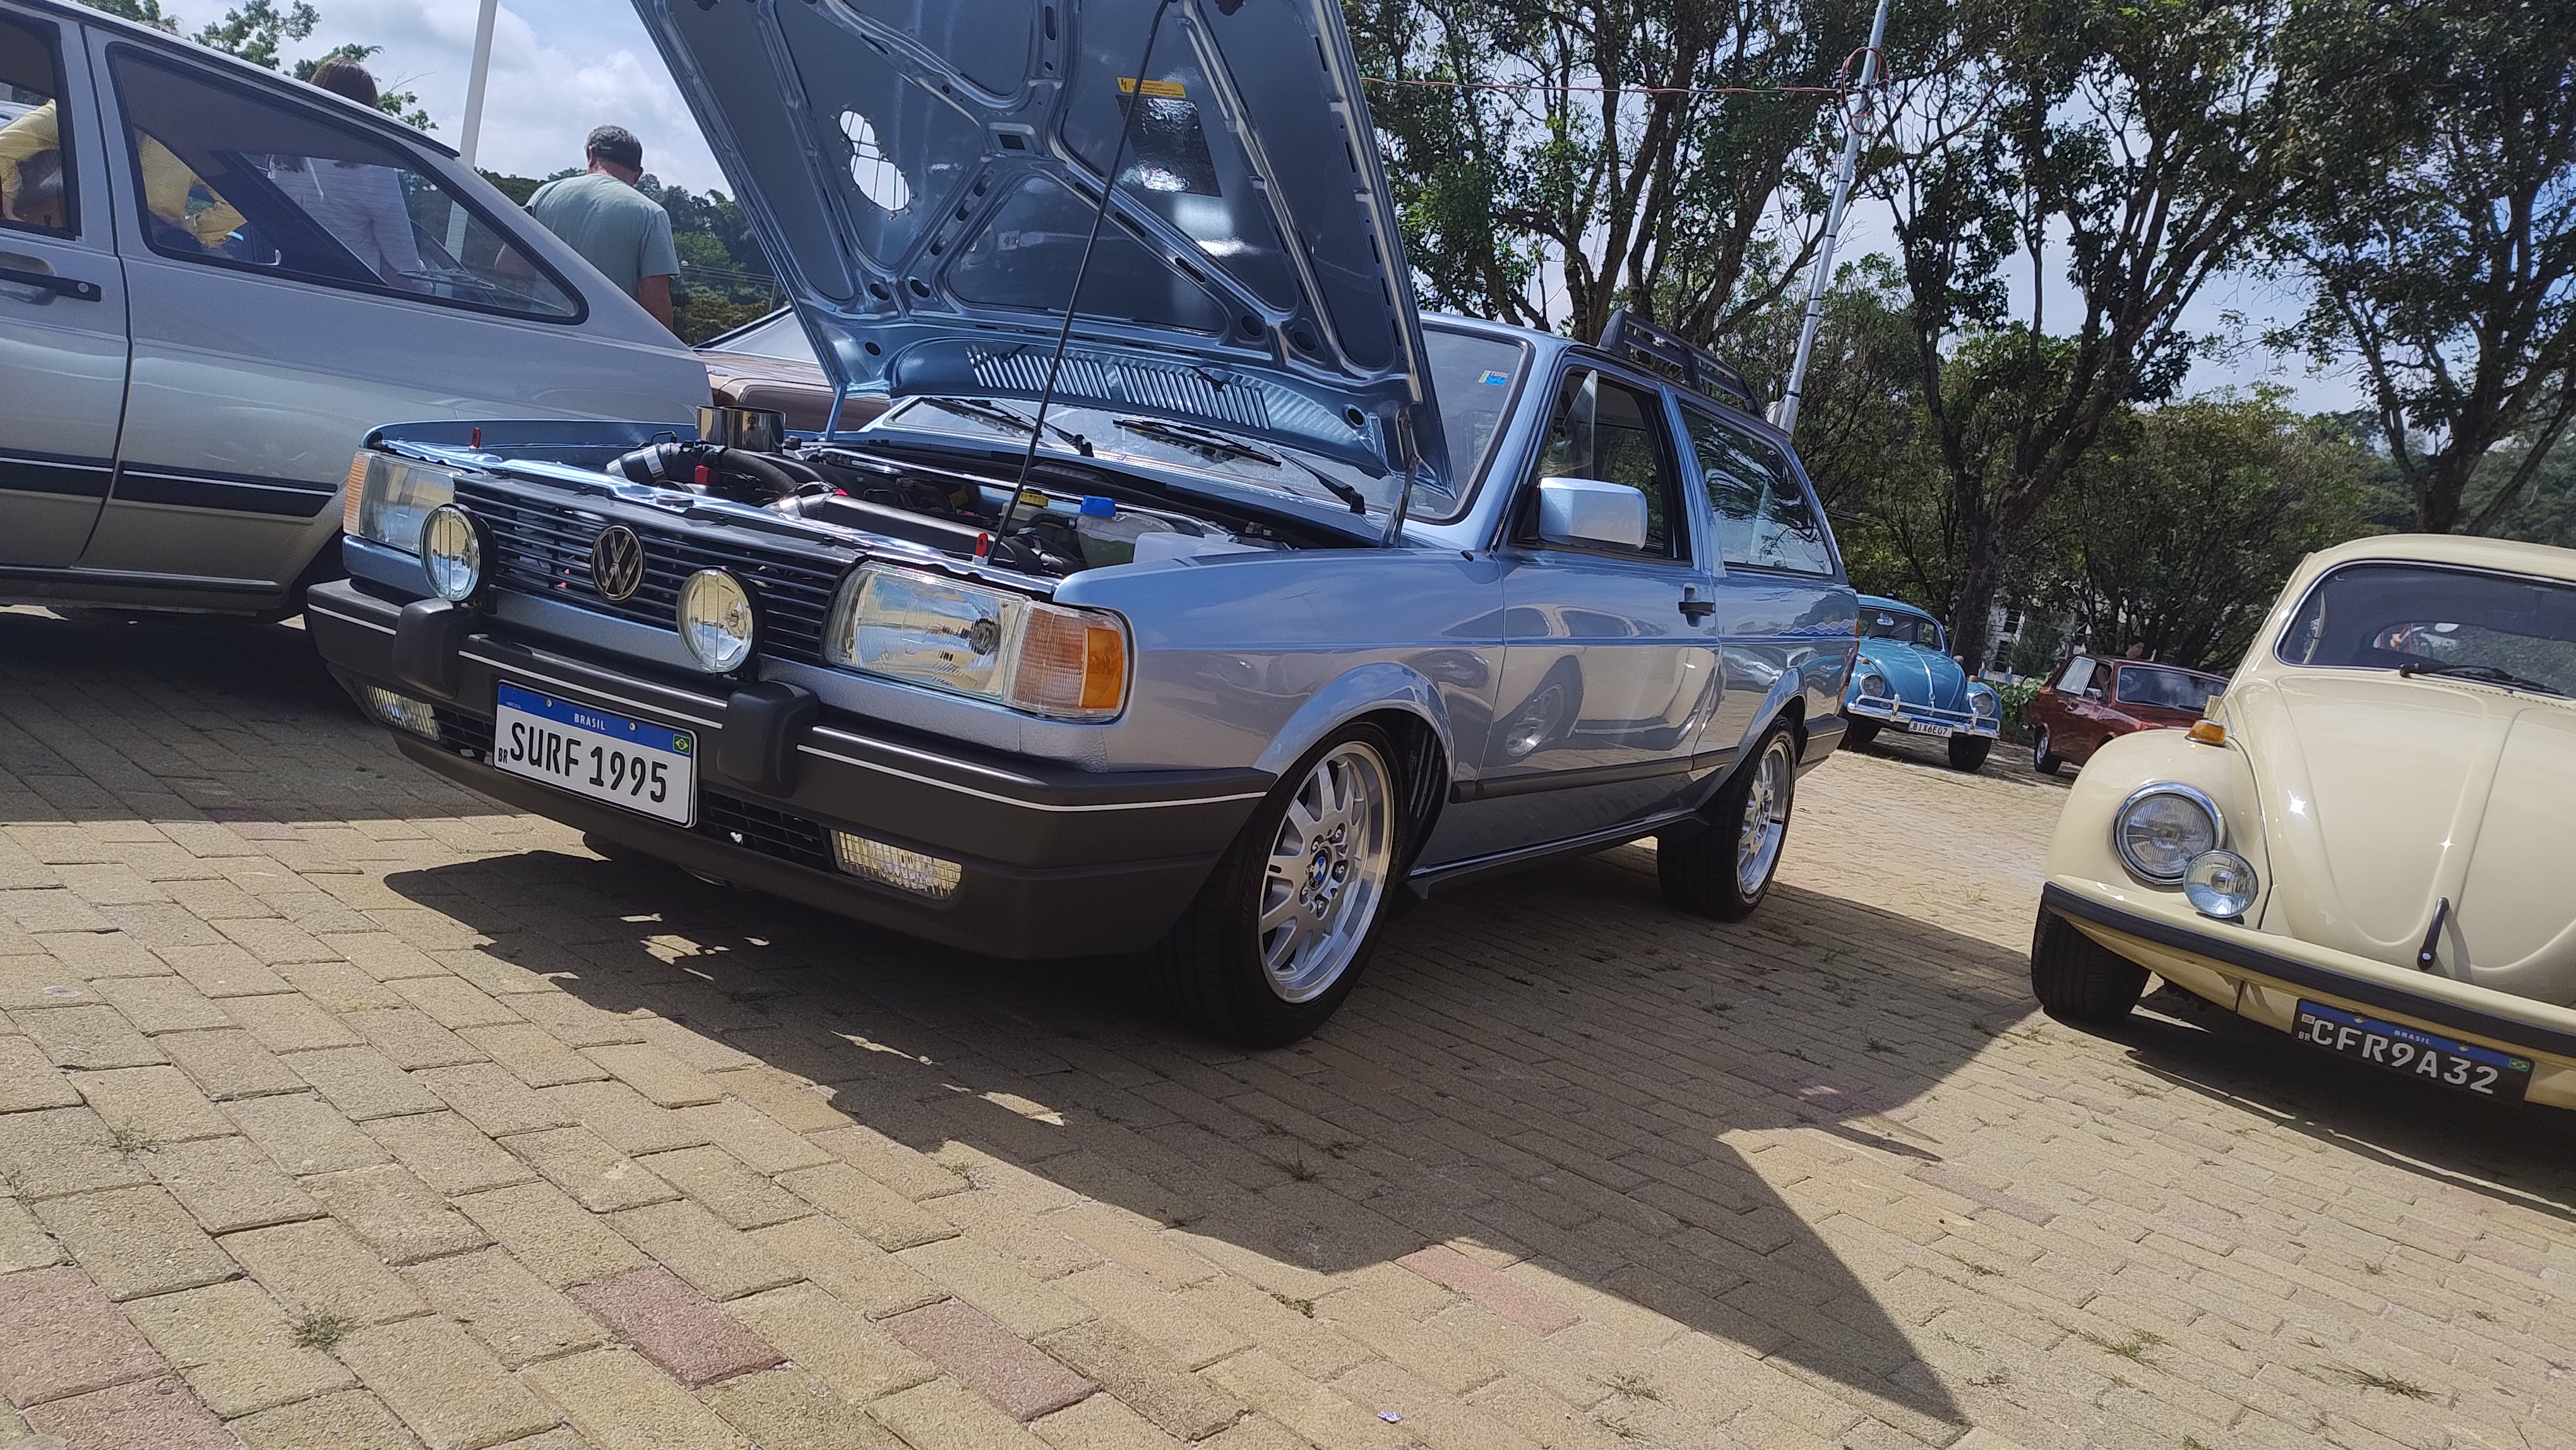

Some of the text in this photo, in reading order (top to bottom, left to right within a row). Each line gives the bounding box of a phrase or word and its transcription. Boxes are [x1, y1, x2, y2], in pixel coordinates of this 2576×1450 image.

[573, 712, 606, 731] BRASIL
[498, 747, 508, 765] BR
[510, 722, 668, 803] SURF 1995
[2298, 1031, 2311, 1041] BR
[2394, 1029, 2430, 1045] BRASIL
[2311, 1019, 2498, 1094] CFR9A32
